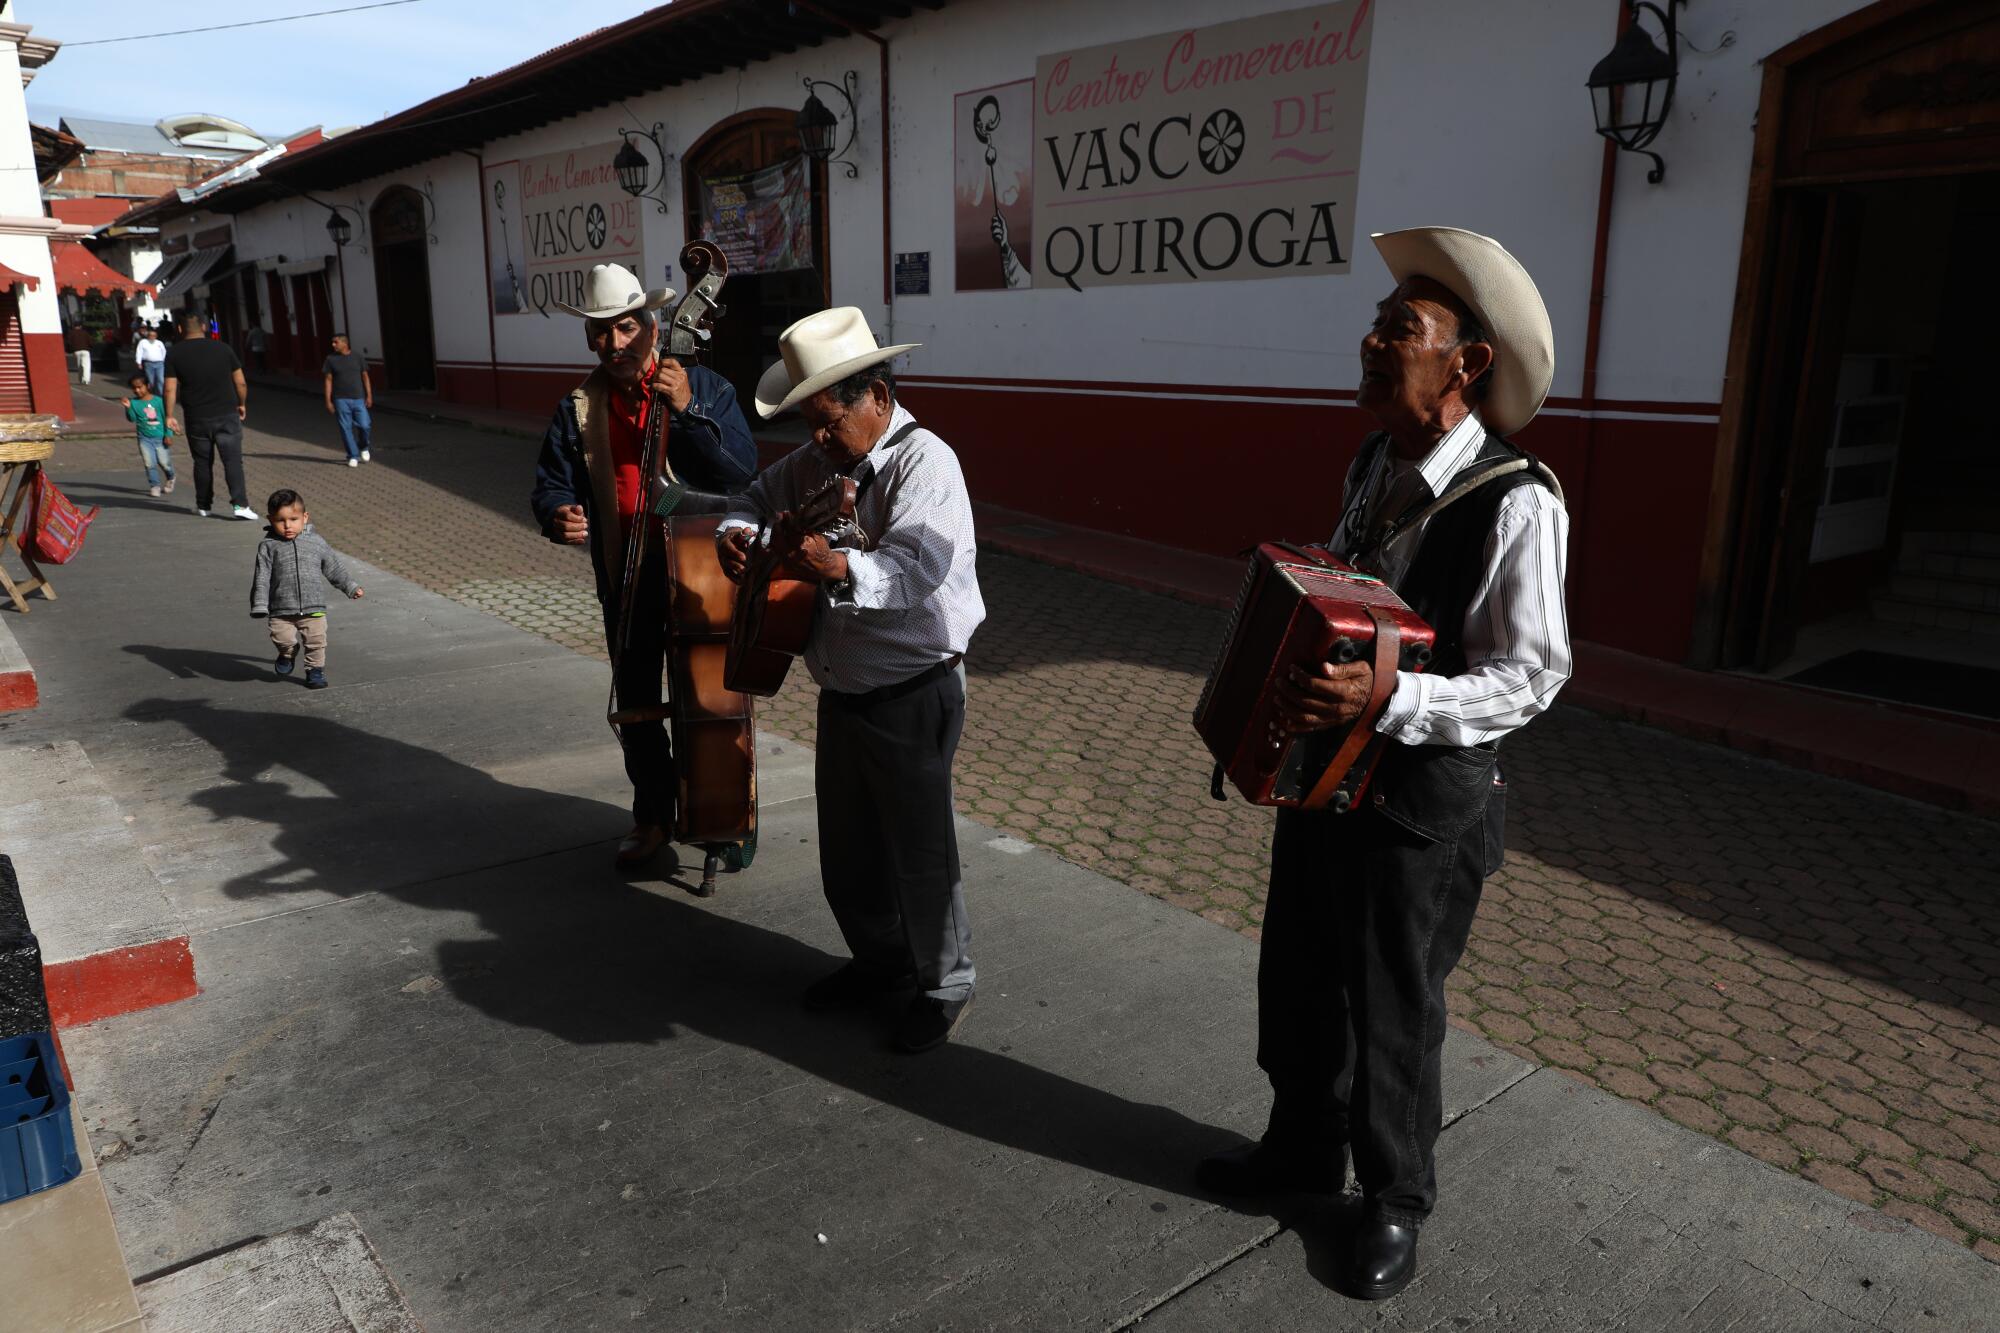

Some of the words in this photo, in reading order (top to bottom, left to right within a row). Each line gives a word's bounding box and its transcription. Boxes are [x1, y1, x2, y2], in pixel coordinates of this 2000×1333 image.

[1043, 56, 1154, 116] Centro
[1163, 0, 1369, 95] Comercial
[522, 164, 562, 199] Centro
[1044, 108, 1246, 192] VASCO
[1271, 88, 1336, 140] DE
[525, 203, 607, 258] VASCO
[611, 200, 637, 231] DE
[1045, 201, 1348, 293] QUIROGA
